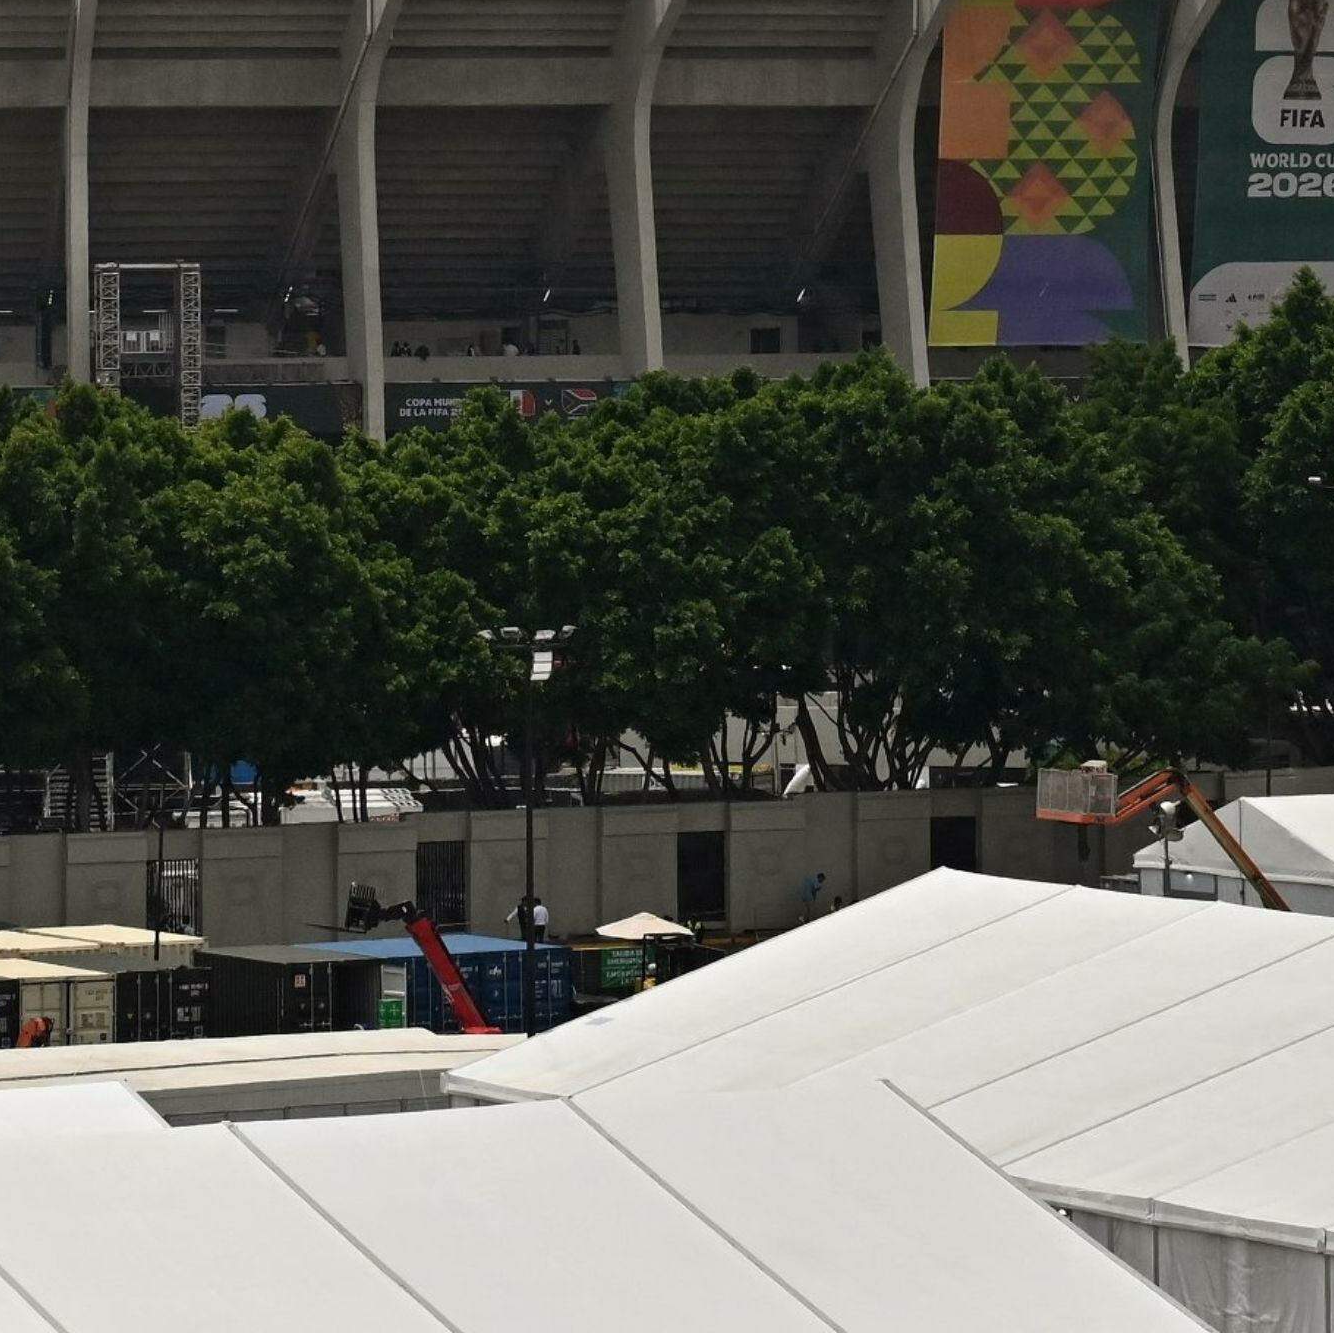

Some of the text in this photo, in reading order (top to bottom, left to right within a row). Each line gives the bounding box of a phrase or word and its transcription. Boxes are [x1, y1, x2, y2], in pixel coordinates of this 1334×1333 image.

[1279, 109, 1325, 128] FIFA
[1249, 152, 1312, 168] WORLD
[405, 398, 432, 407] COPA
[399, 408, 412, 417] DE
[413, 408, 426, 417] LA
[427, 408, 448, 417] FIFA
